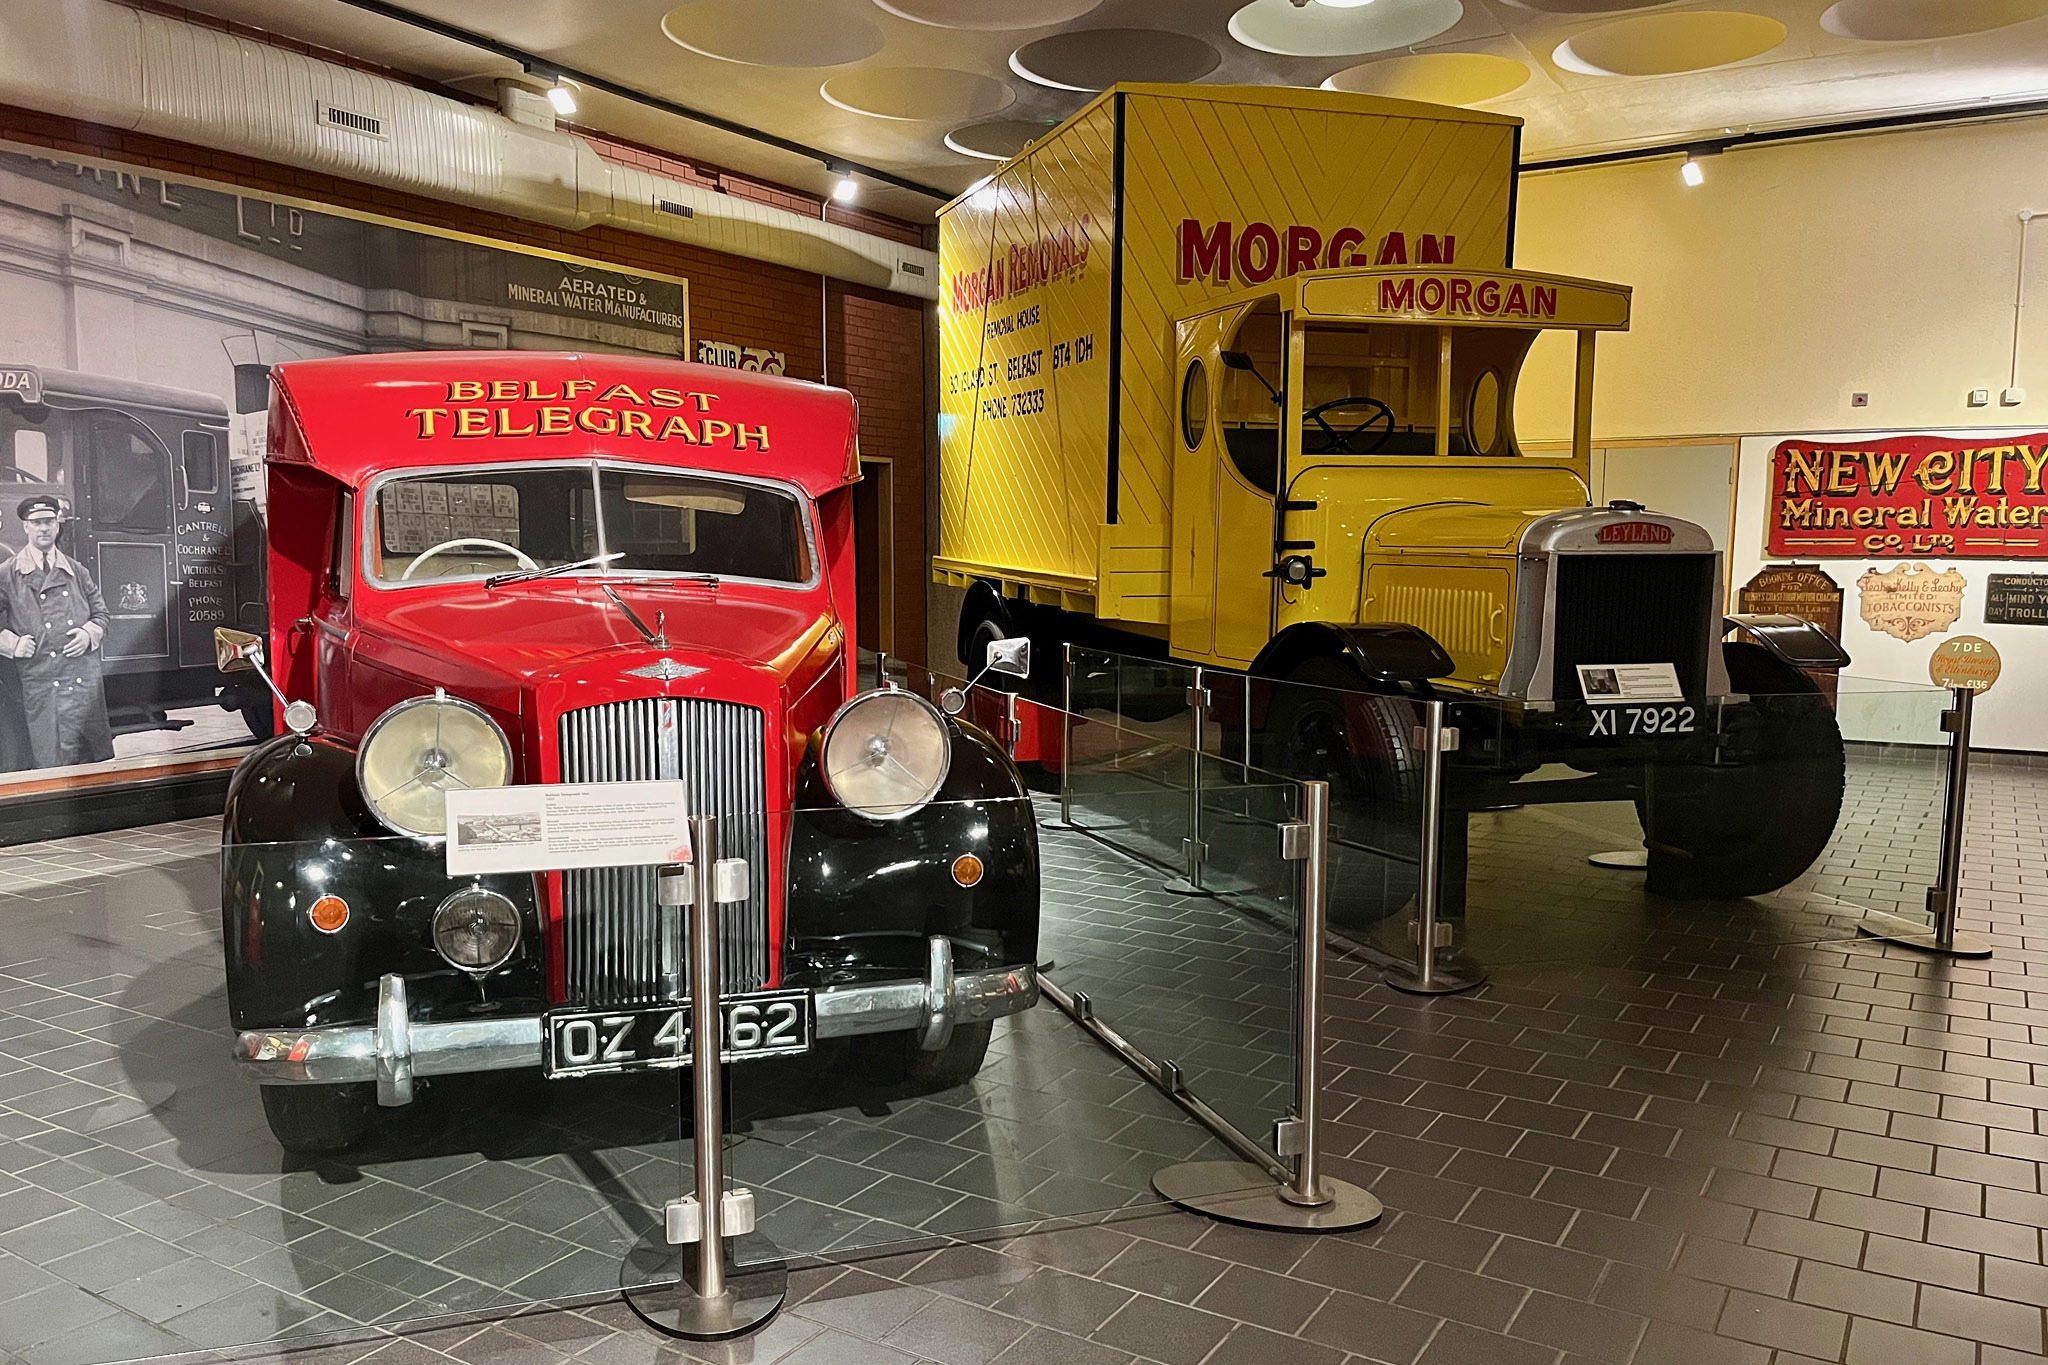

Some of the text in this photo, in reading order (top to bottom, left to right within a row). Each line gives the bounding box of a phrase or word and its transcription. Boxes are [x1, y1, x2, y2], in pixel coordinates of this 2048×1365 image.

[1177, 218, 1456, 284] MORGAN
[952, 213, 1091, 317] MORGAN REMOVALS
[559, 276, 647, 305] AERATED &
[1378, 277, 1558, 318] MORGAN
[508, 283, 683, 329] MINERAL WATER MANUFACTURERS
[986, 304, 1041, 340] REMOVAL HOUSE
[706, 347, 737, 369] CLUB
[1007, 350, 1043, 381] BELFAST
[1053, 341, 1071, 370] BT4
[1075, 334, 1094, 366] 1DH
[0, 372, 31, 390] DA
[446, 380, 720, 412] BELFAST
[983, 388, 1045, 422] PHONE 732333
[407, 406, 770, 453] TELEGRAPH
[1783, 443, 2048, 498] NEW CITY
[1780, 496, 2048, 530] Mineral Water
[177, 521, 228, 538] CANTRELL
[202, 533, 210, 542] &
[1602, 523, 1669, 542] LEYLAND
[177, 544, 221, 556] COCHRANE
[182, 564, 217, 575] VICTORIA
[188, 578, 223, 588] BELFAST
[1758, 571, 1830, 590] BOOKING OFFICE
[1780, 583, 1802, 592] FOR
[1894, 578, 1920, 594] Kelly
[1922, 580, 1930, 593] &
[1931, 577, 1962, 594] Leahy
[188, 596, 223, 608] PHONE
[1888, 592, 1934, 601] LIMITED
[1991, 594, 2004, 602] ALL
[2009, 594, 2048, 605] MIND Y
[188, 610, 225, 622] 20589
[1866, 602, 1955, 613] TOBACCONISTS
[1988, 607, 2004, 616] DAY
[2008, 608, 2048, 618] TROLL
[1588, 706, 1696, 736] XI 7922
[562, 1002, 798, 1064] OZ 462
